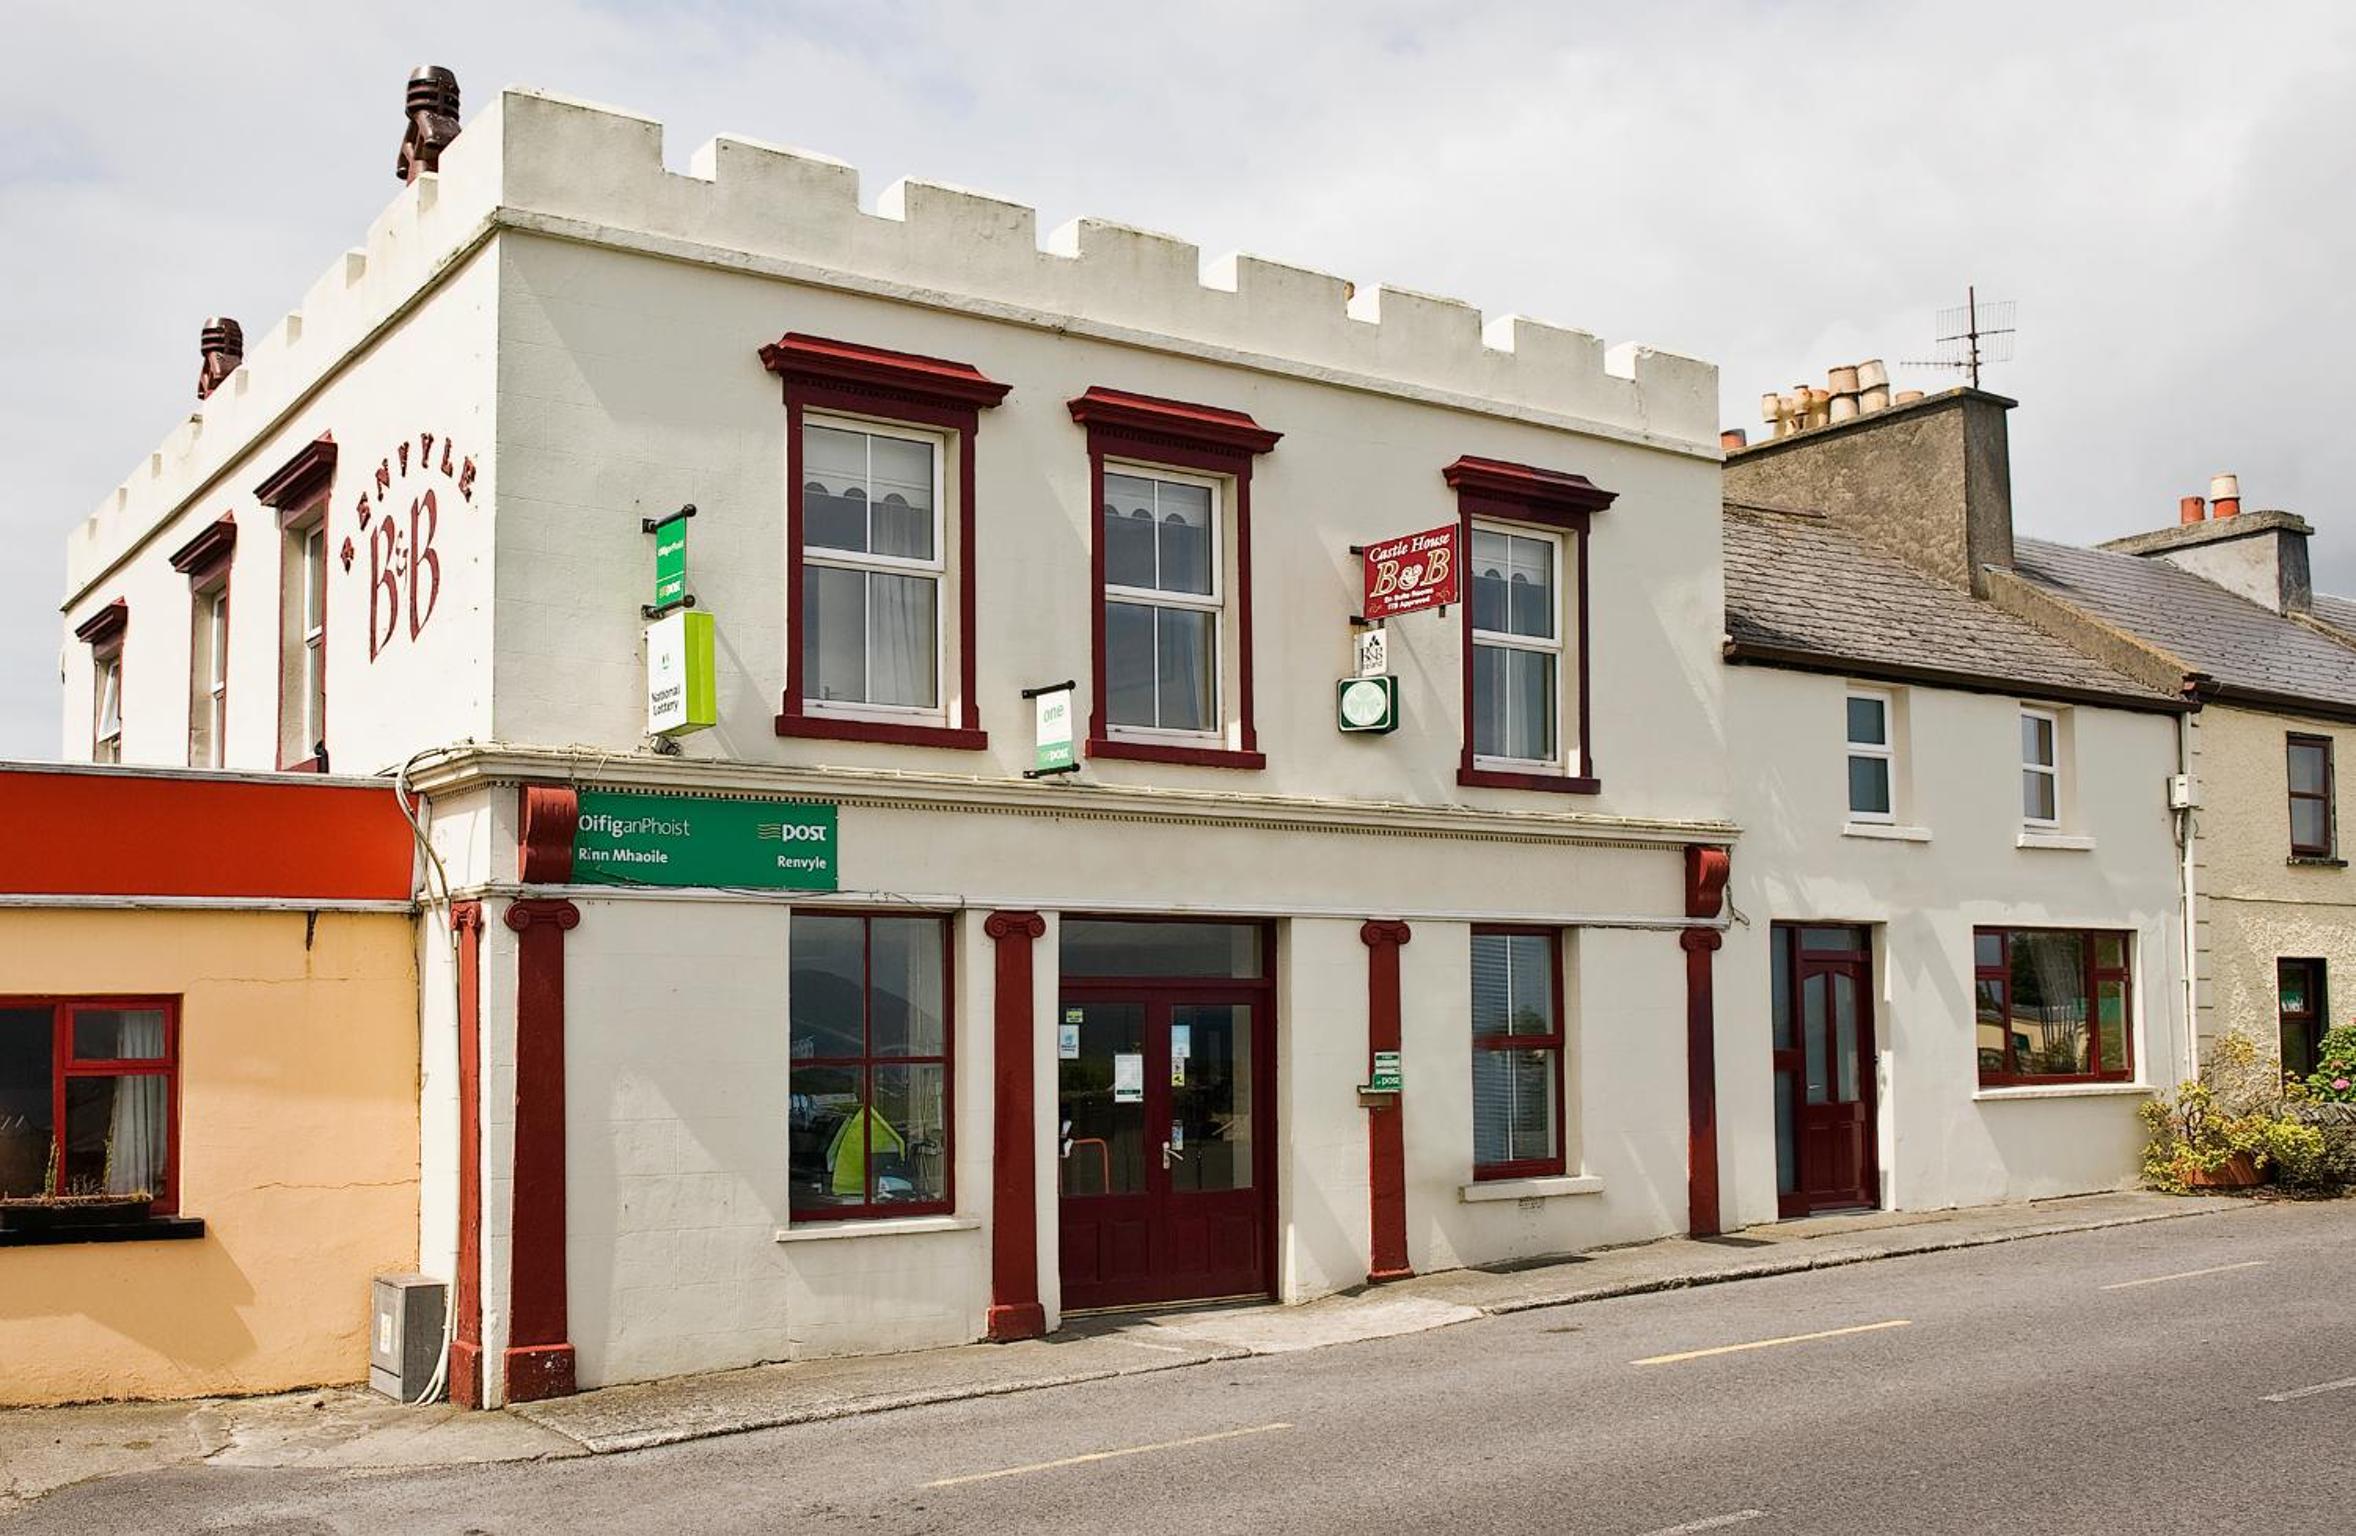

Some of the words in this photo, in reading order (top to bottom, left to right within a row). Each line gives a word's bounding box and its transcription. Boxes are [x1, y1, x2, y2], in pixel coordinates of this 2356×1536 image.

[1369, 541, 1409, 563] Castle
[1410, 533, 1451, 554] House
[369, 488, 441, 665] B&B
[1369, 547, 1451, 598] B&B
[651, 684, 681, 702] National
[653, 700, 679, 716] Lottery
[612, 848, 669, 864] Mhaoile
[777, 855, 827, 872] Renvyle
